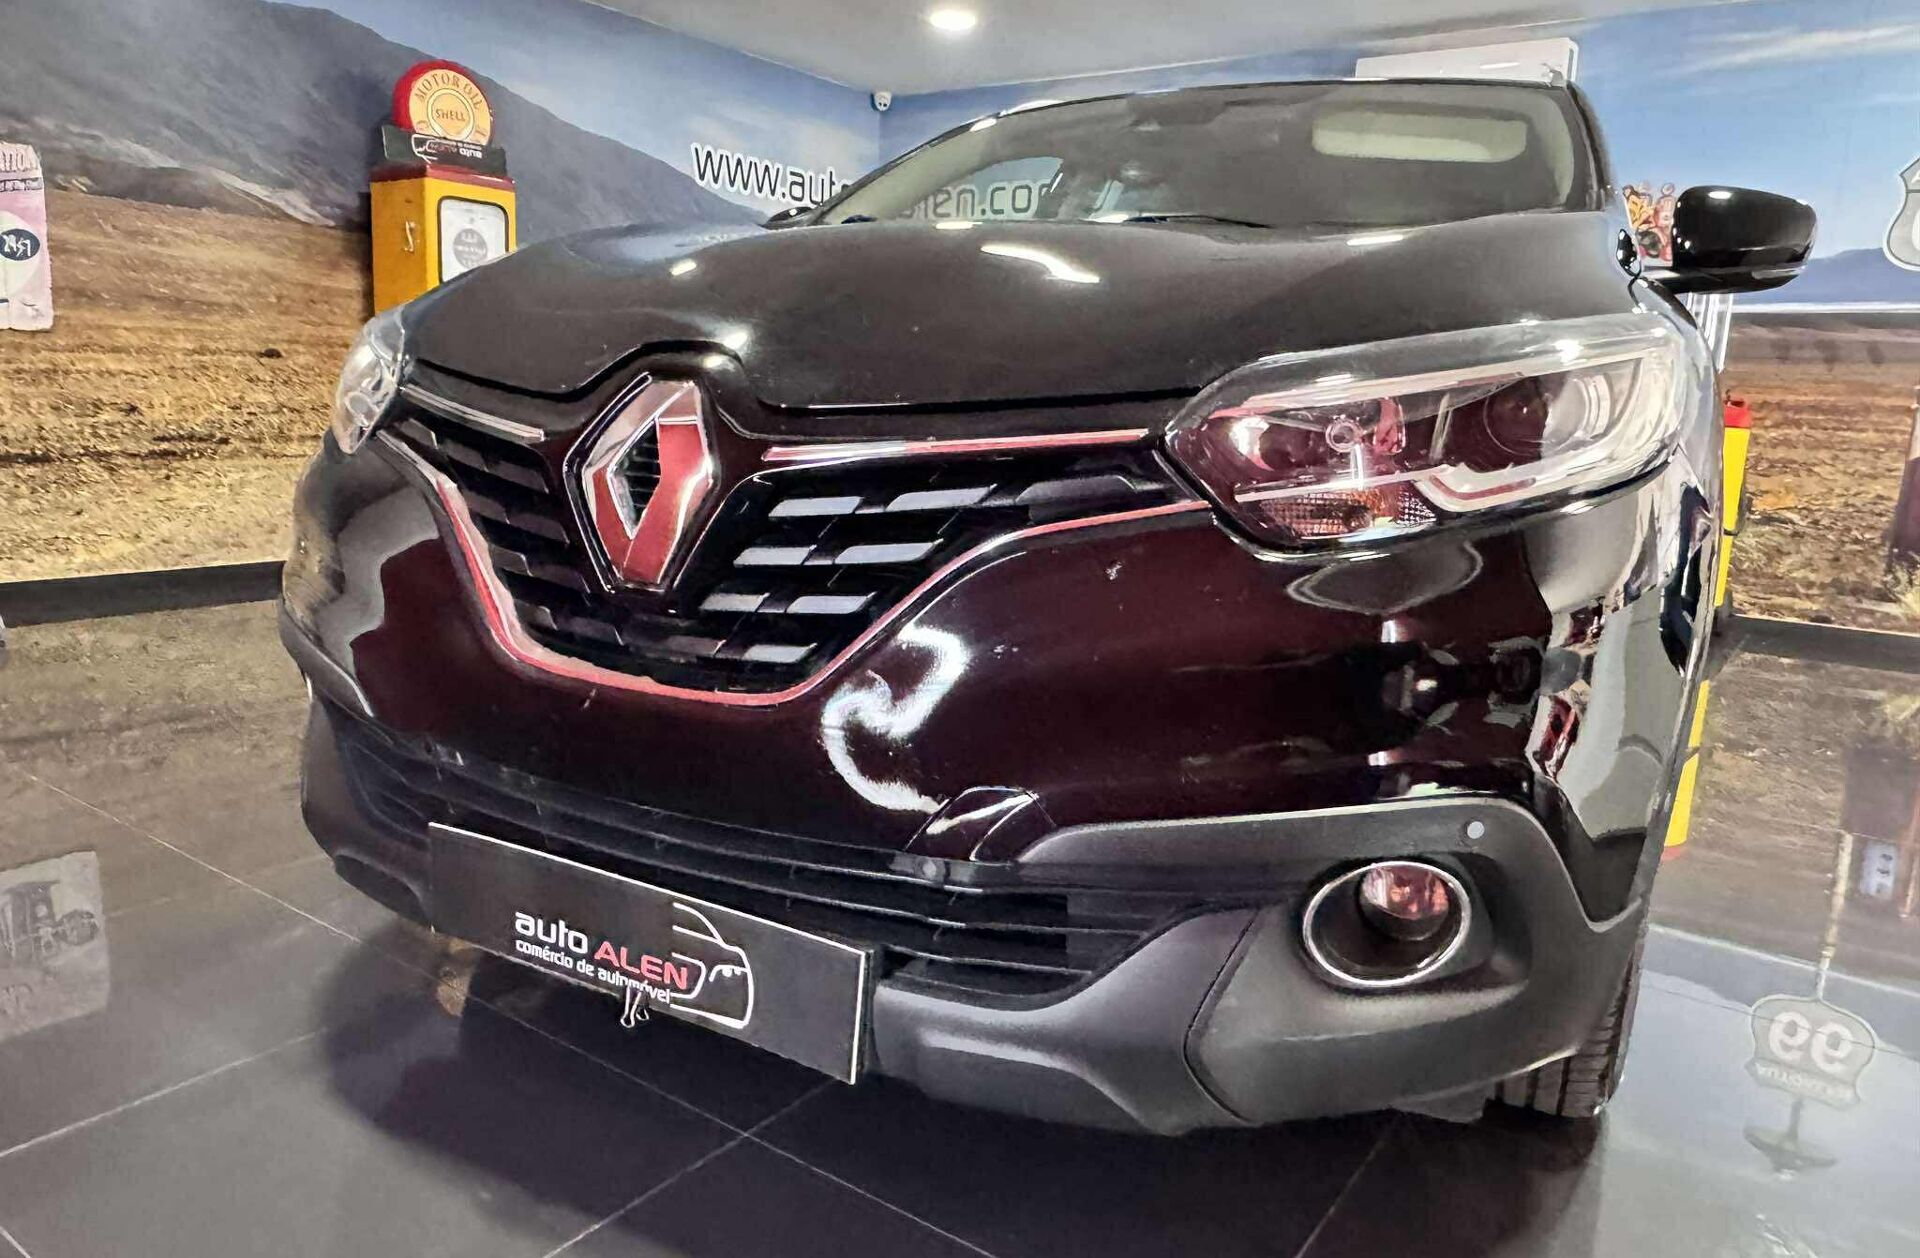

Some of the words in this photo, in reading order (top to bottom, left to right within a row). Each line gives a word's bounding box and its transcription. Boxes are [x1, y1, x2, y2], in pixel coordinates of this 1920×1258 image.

[435, 108, 465, 122] SHELL
[515, 911, 588, 954] auto
[593, 940, 688, 989] ALEN
[515, 939, 573, 969] comércio
[576, 958, 595, 977] de
